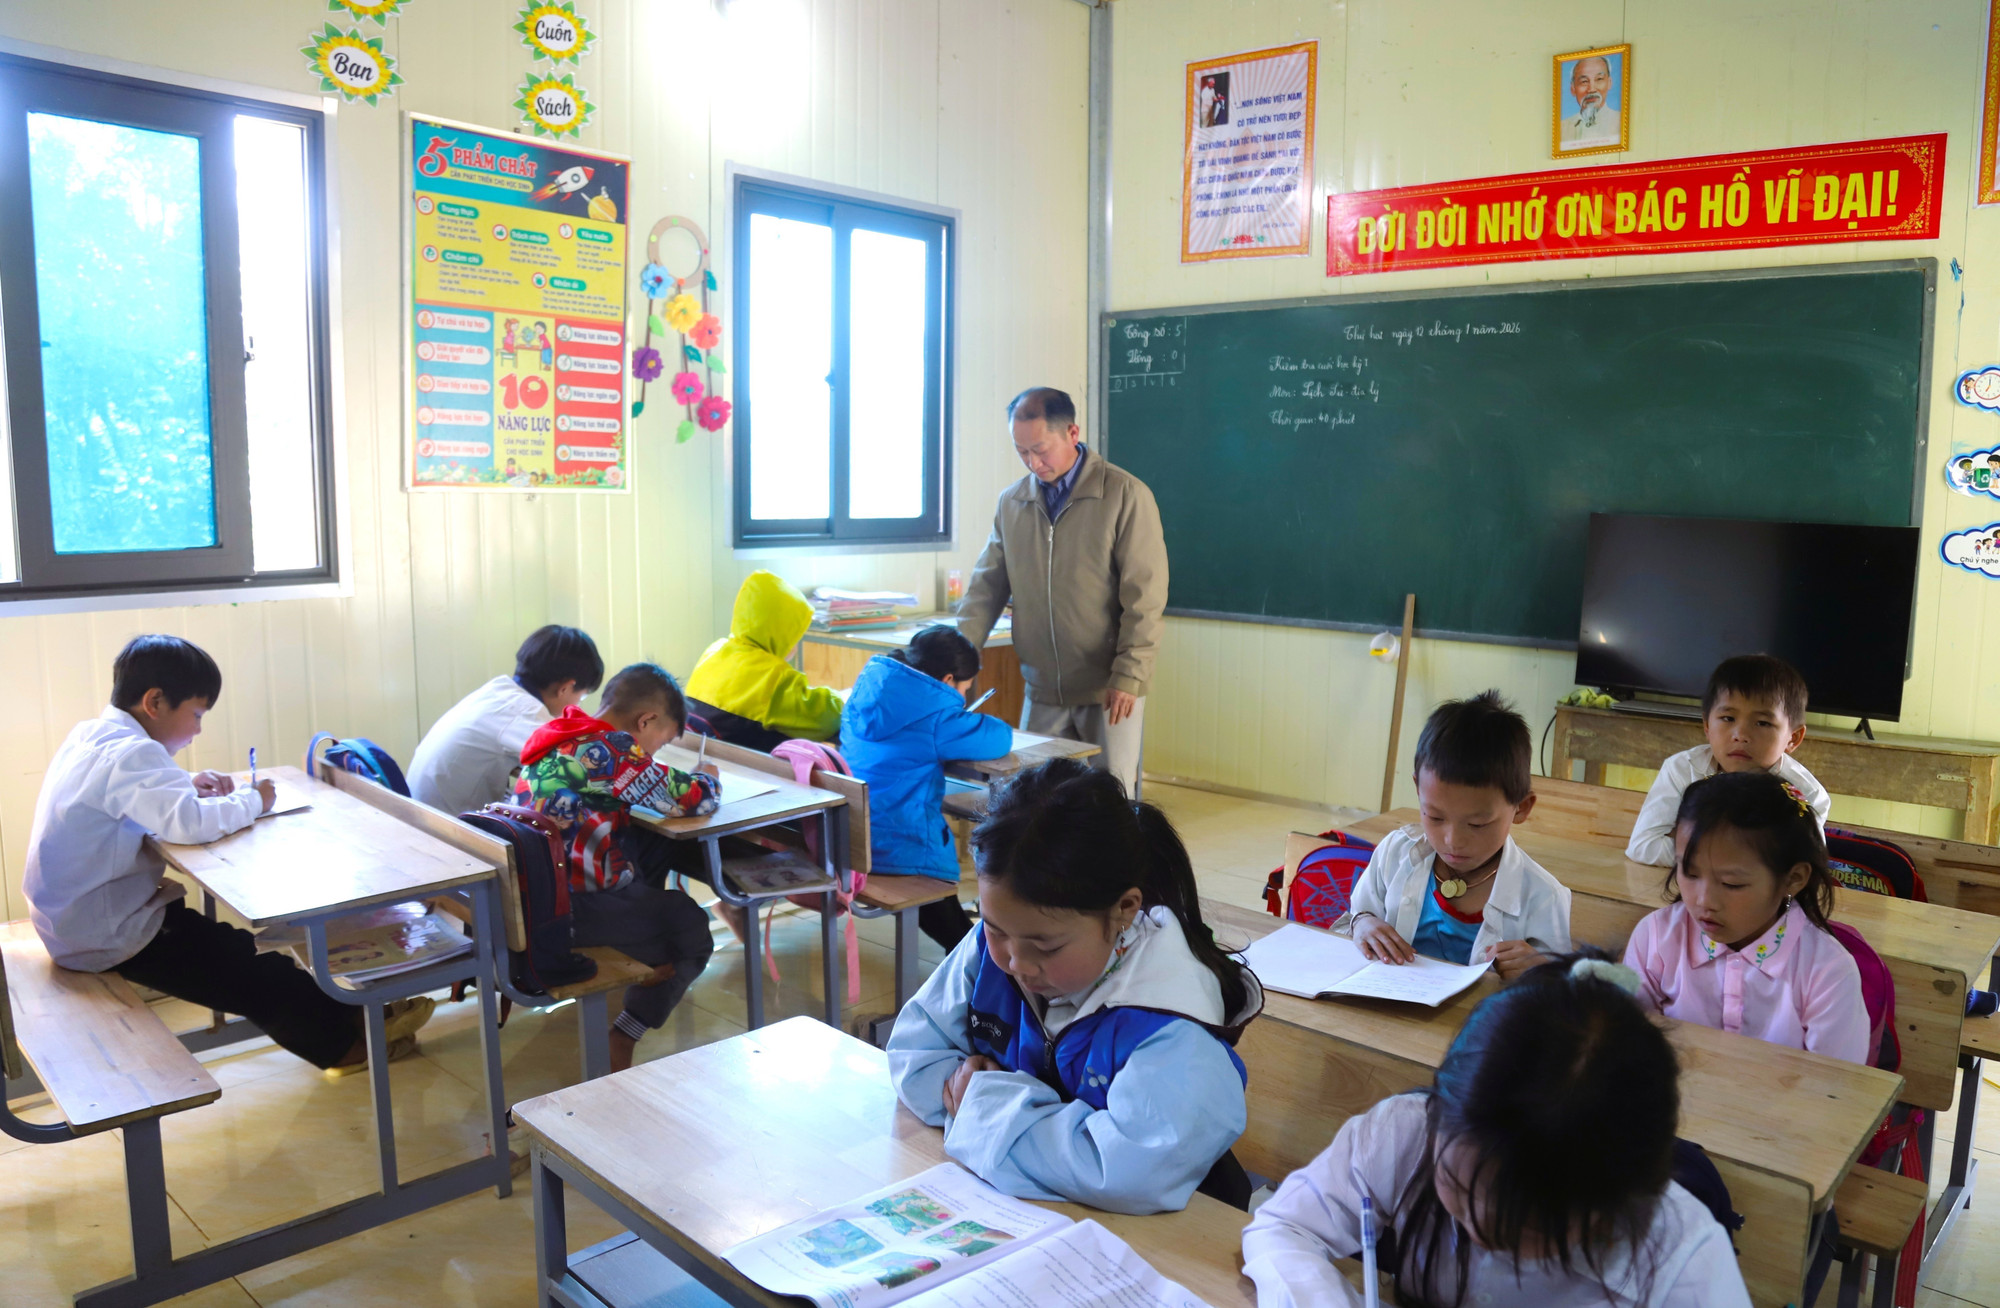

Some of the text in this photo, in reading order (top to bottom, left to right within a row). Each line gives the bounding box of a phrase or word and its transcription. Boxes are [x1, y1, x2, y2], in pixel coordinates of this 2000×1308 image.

[535, 20, 572, 42] Cuốn
[334, 52, 374, 81] Bạn
[536, 96, 572, 116] Sách
[1287, 92, 1302, 101] NAM
[1263, 132, 1276, 142] NAM
[418, 137, 538, 178] 5 PHẨM CHẤT
[1358, 167, 1899, 254] ĐỜI ĐỜI NHỚ ƠN BÁC HỒ VĨ ĐẠI!
[1392, 327, 1413, 346] ngày
[1428, 320, 1462, 343] tháng
[1466, 324, 1470, 334] 1
[1472, 324, 1498, 334] năm
[1500, 322, 1521, 334] 2026
[498, 373, 549, 410] 10
[1302, 381, 1325, 399] Lịch
[498, 411, 528, 431] NĂNG
[531, 416, 551, 436] LỰC
[1976, 556, 1980, 564] ý
[614, 767, 639, 790] MARVEL
